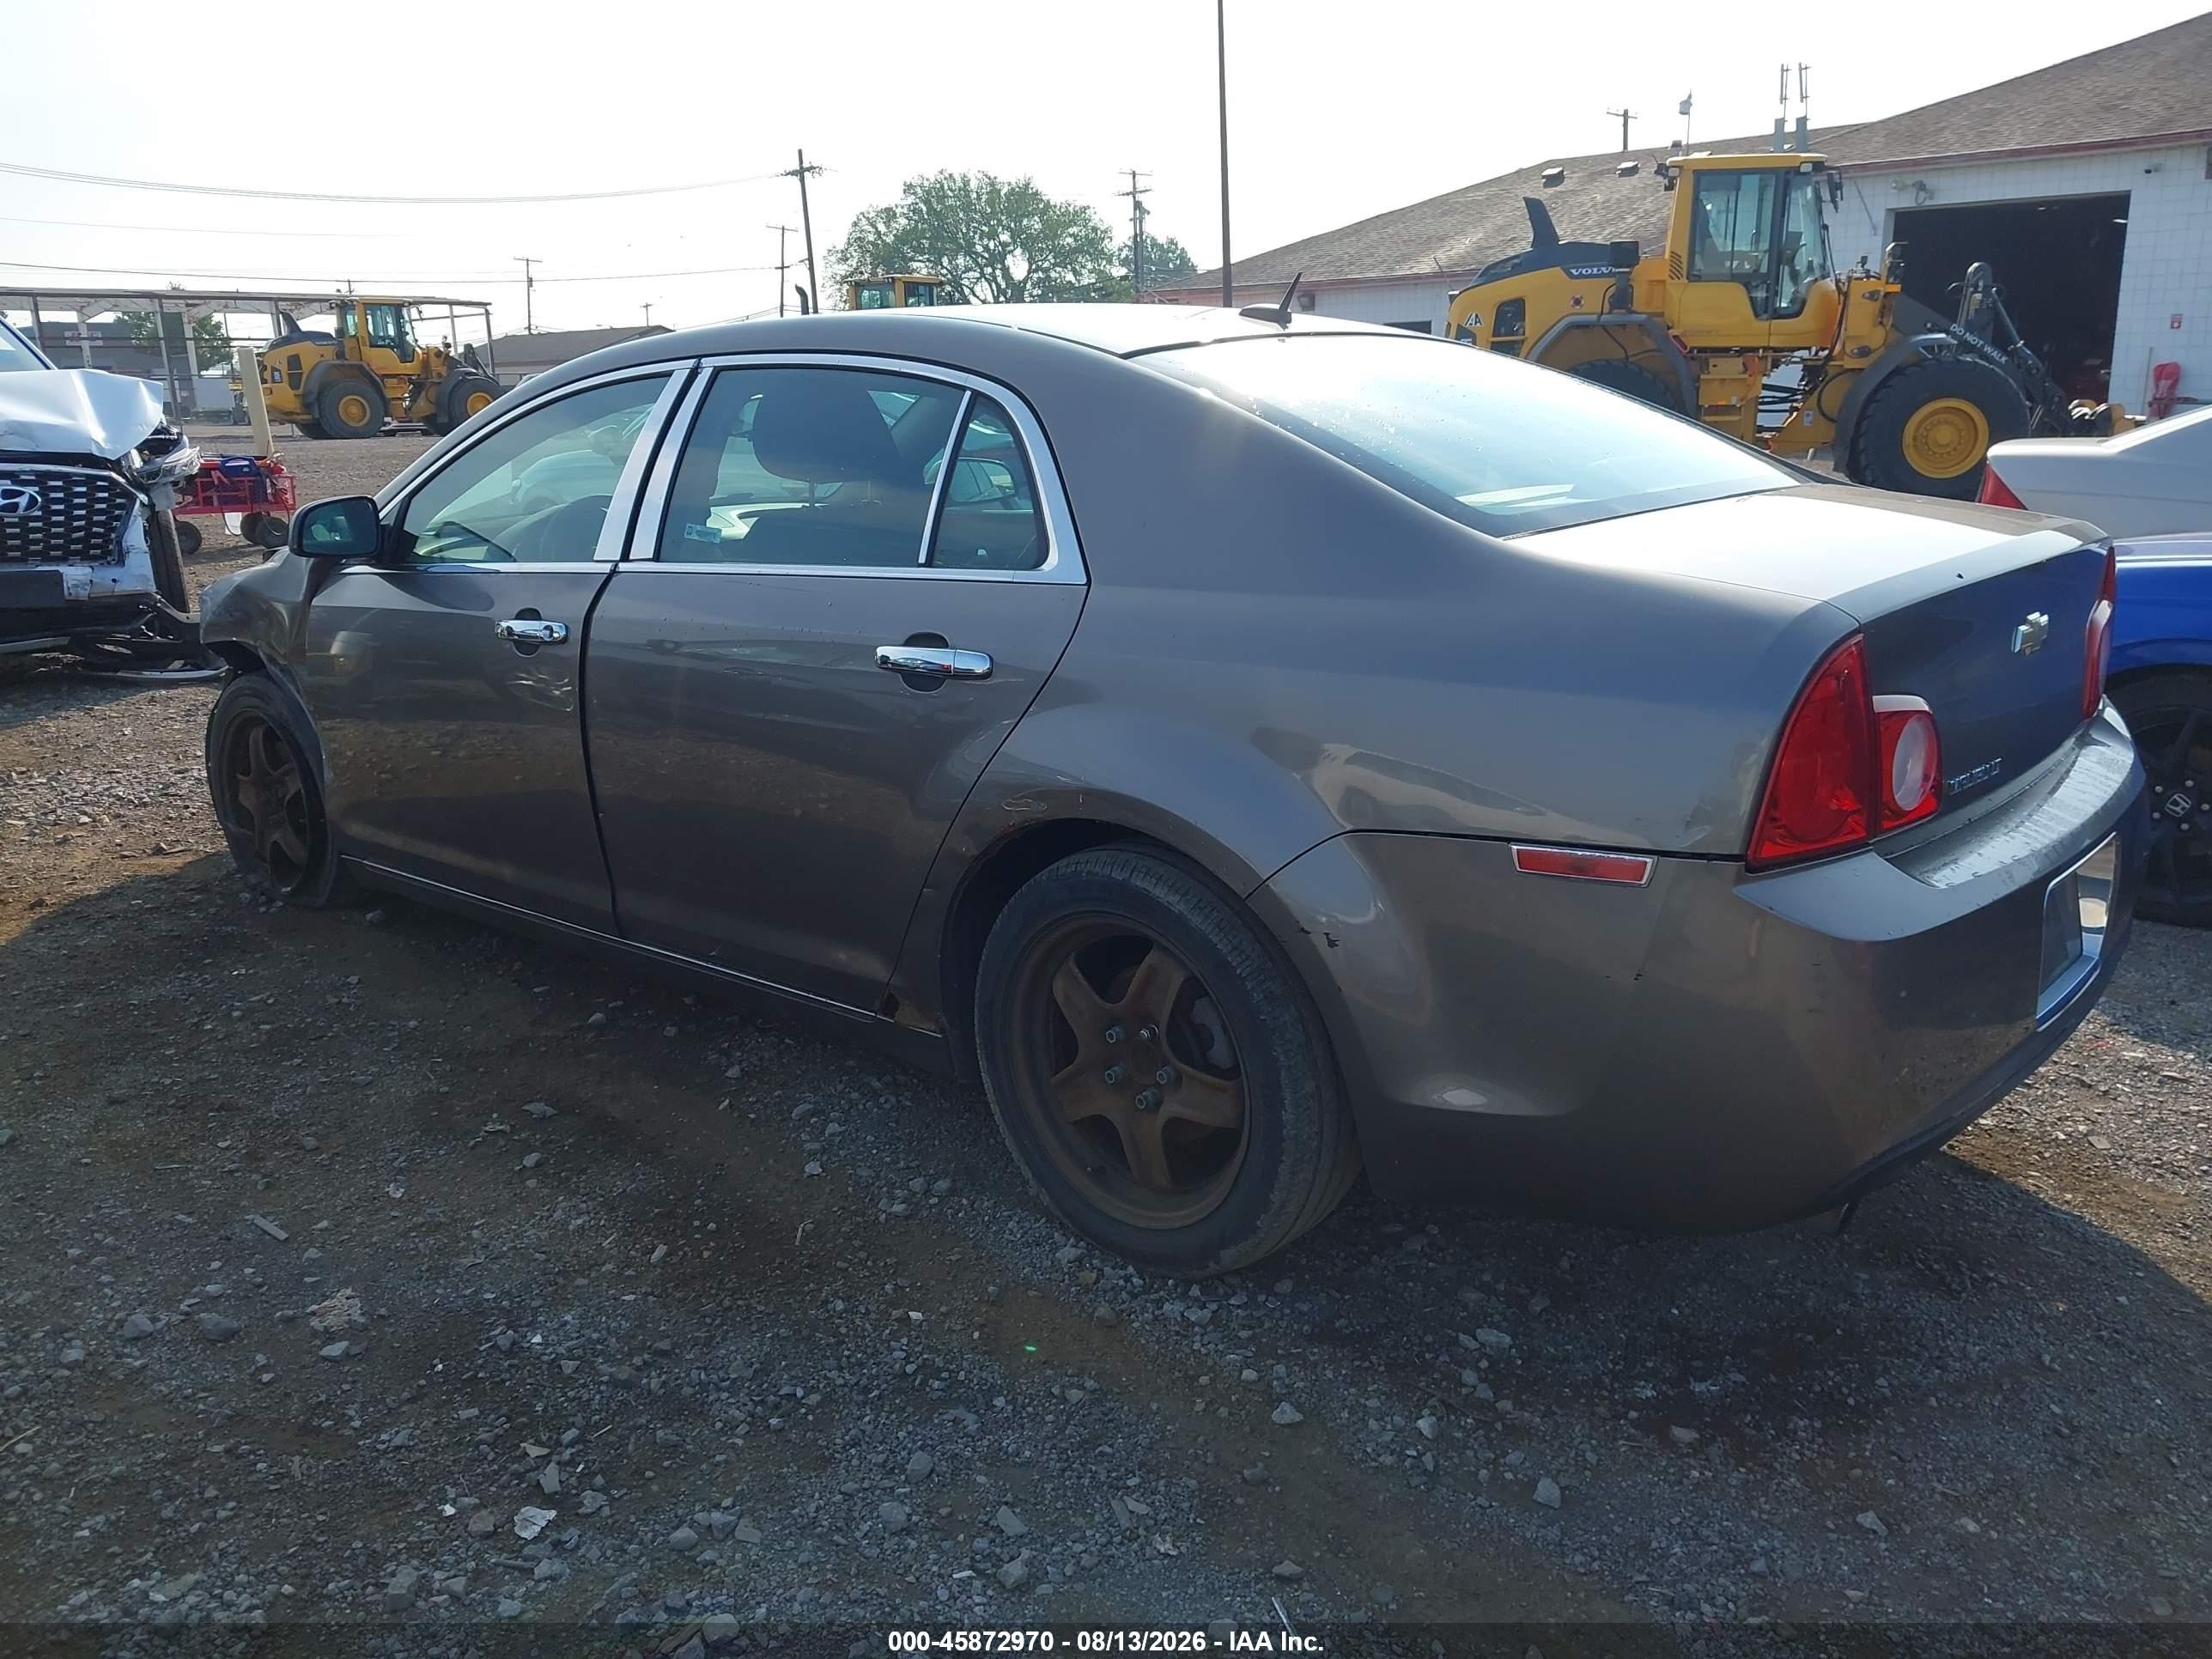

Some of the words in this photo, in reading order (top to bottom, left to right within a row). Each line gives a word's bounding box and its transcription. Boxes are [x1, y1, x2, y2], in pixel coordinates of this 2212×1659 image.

[1569, 266, 1615, 275] VOLV
[1950, 323, 1965, 336] DO
[1963, 331, 1984, 347] NOT
[1984, 343, 2008, 364] WALK
